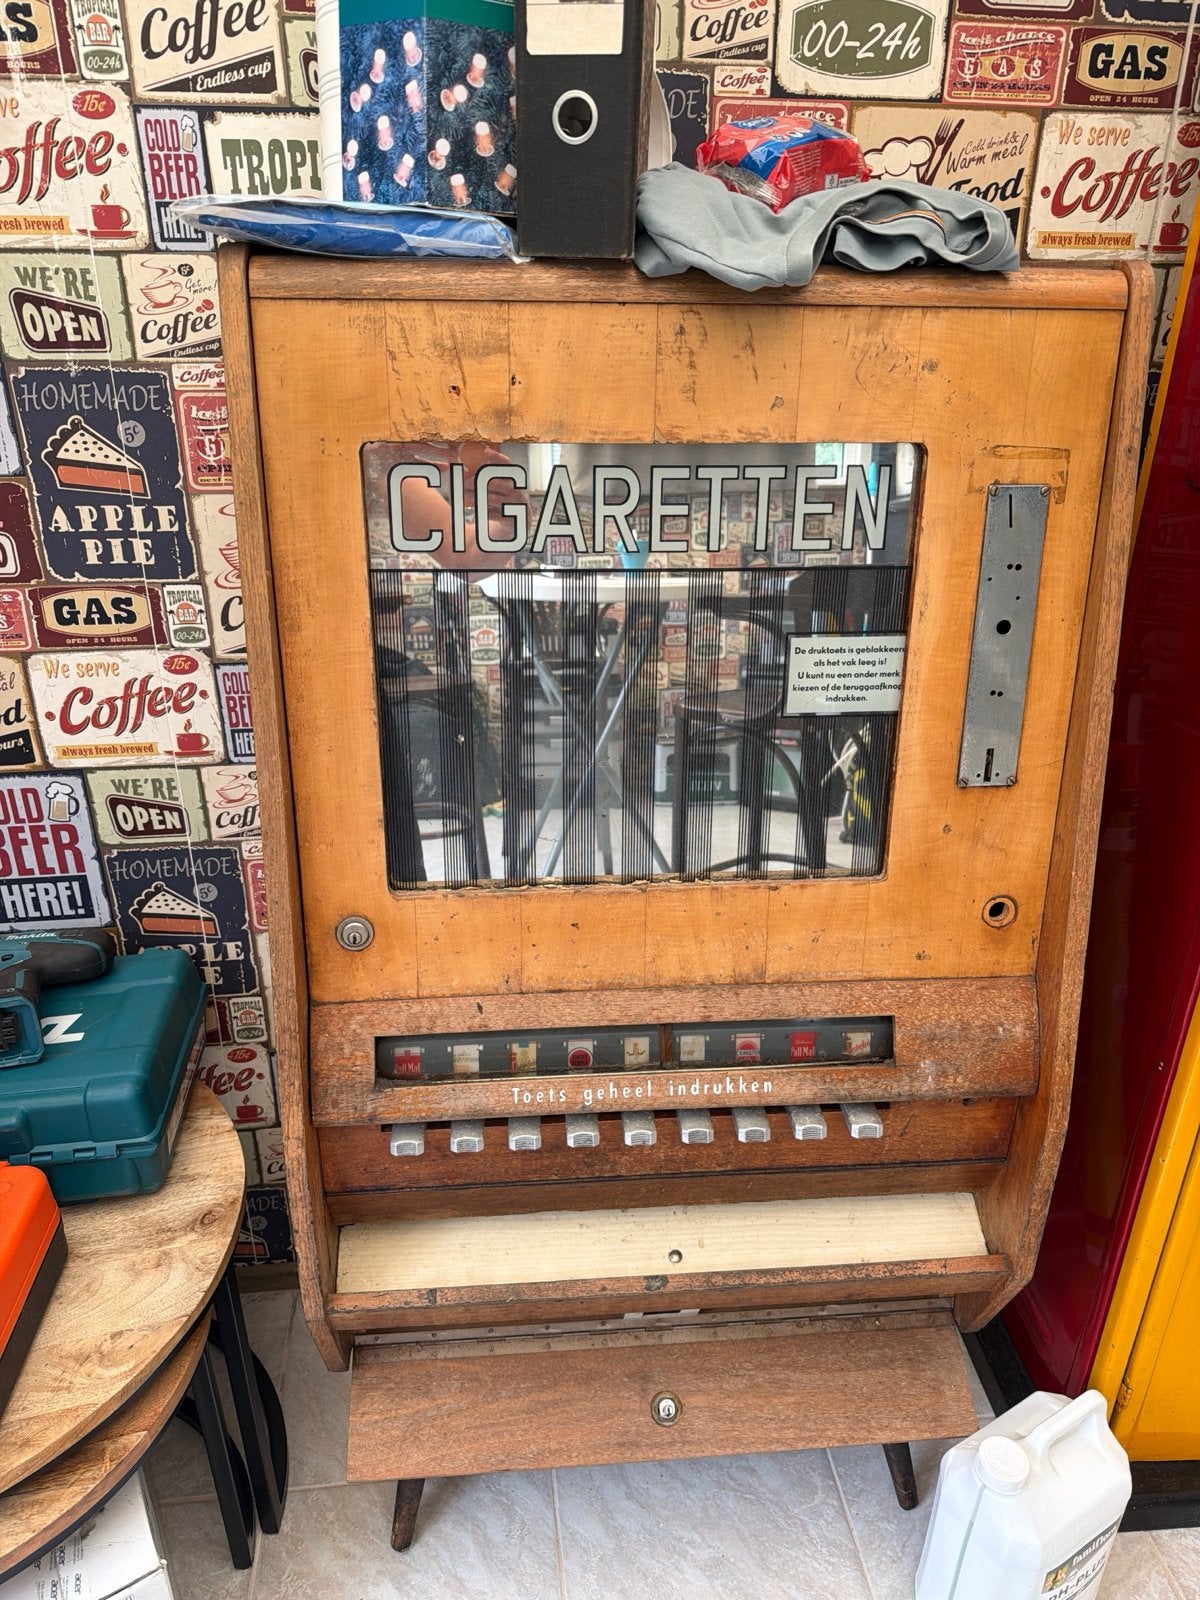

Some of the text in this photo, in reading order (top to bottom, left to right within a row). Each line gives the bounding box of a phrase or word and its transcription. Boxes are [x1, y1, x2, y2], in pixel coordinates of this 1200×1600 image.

[88, 22, 111, 42] BAR
[141, 0, 270, 64] Coffee
[690, 5, 769, 44] Coffee
[803, 16, 923, 60] 00-24h
[996, 31, 1056, 44] chance
[87, 54, 121, 69] 00-24h
[718, 41, 767, 60] Endless cup
[1087, 43, 1168, 81] GAS
[196, 59, 272, 91] Endless cup
[720, 73, 765, 89] Coffee
[1089, 95, 1111, 103] OPEN
[1131, 96, 1159, 104] HOURS
[144, 118, 181, 152] COLD
[1058, 119, 1131, 146] We serve
[946, 133, 1029, 175] Warm meal
[964, 137, 986, 156] Cold
[0, 118, 112, 205] offee
[221, 138, 322, 196] TROPI
[148, 153, 201, 200] BEER
[1050, 146, 1199, 224] Coffee
[0, 216, 65, 232] resh brewed
[1042, 233, 1132, 248] always fresh brewed
[14, 266, 97, 303] WE'RE
[185, 278, 202, 291] Get
[192, 280, 218, 295] more!
[21, 302, 102, 342] OPEN
[140, 311, 219, 345] Coffee
[173, 343, 220, 358] Endless cup
[180, 369, 224, 383] Coffee
[20, 380, 162, 413] HOMEMADE
[48, 504, 179, 532] APPLE
[387, 462, 892, 554] CIGARETTEN
[81, 538, 155, 565] PIE
[166, 590, 202, 605] TROPICAL
[53, 597, 137, 626] GAS
[177, 608, 196, 622] BAR
[794, 647, 806, 655] De
[808, 646, 846, 654] druktoets
[43, 658, 120, 679] We serve
[806, 671, 824, 679] kunt
[813, 659, 825, 667] als
[827, 658, 840, 667] het
[841, 658, 857, 666] vak
[858, 658, 876, 668] leeg
[821, 683, 829, 691] of
[831, 682, 841, 691] de
[825, 694, 868, 702] indrukken.
[59, 675, 198, 736] Coffee
[61, 744, 154, 757] always fresh brewed
[111, 777, 180, 801] WE'RE
[115, 803, 183, 832] OPEN
[215, 804, 261, 828] Coff
[113, 856, 232, 882] HOMEMADE
[1, 881, 86, 919] HERE!
[6, 932, 57, 941] makita
[232, 1000, 263, 1013] TROPICAL
[241, 1014, 256, 1023] BAR
[512, 1076, 773, 1106] Toets geheel indrukken
